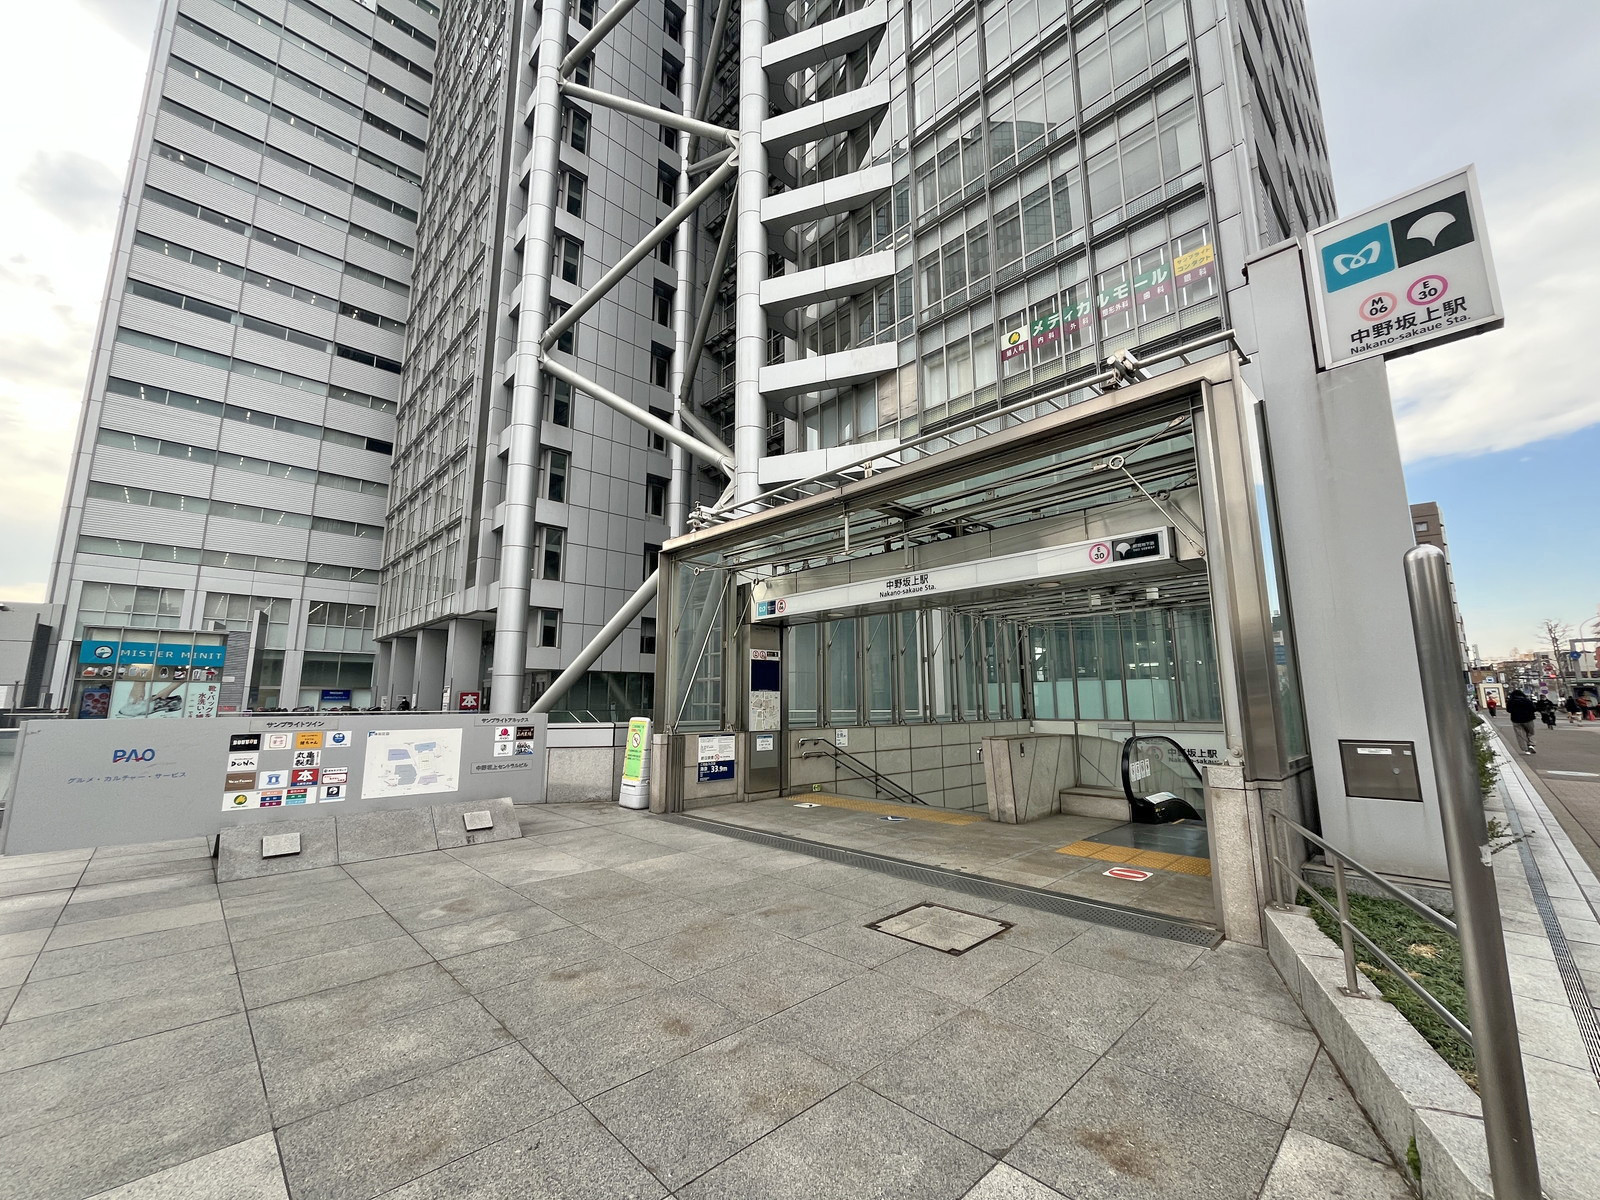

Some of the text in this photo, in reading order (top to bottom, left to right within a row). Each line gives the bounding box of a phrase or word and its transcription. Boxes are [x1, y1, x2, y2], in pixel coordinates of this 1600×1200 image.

[1177, 255, 1212, 272] コンタクト
[1422, 280, 1431, 290] E
[1418, 287, 1438, 300] 30
[1371, 296, 1384, 307] M
[1369, 304, 1389, 317] 06
[1350, 296, 1468, 344] 中野坂上駅
[1037, 331, 1055, 344] 内科
[1070, 316, 1090, 331] 外科
[1350, 314, 1471, 355] Nakano-sakaue Sta.
[1094, 552, 1105, 560] 30
[886, 573, 929, 590] 中野坂上駅
[879, 587, 924, 598] Nakano-sakaue
[120, 649, 222, 660] MISTER MINIT
[461, 694, 478, 707] 本
[266, 720, 325, 728] サンブライトツイン
[112, 748, 156, 763] PAO
[296, 769, 314, 781] 本
